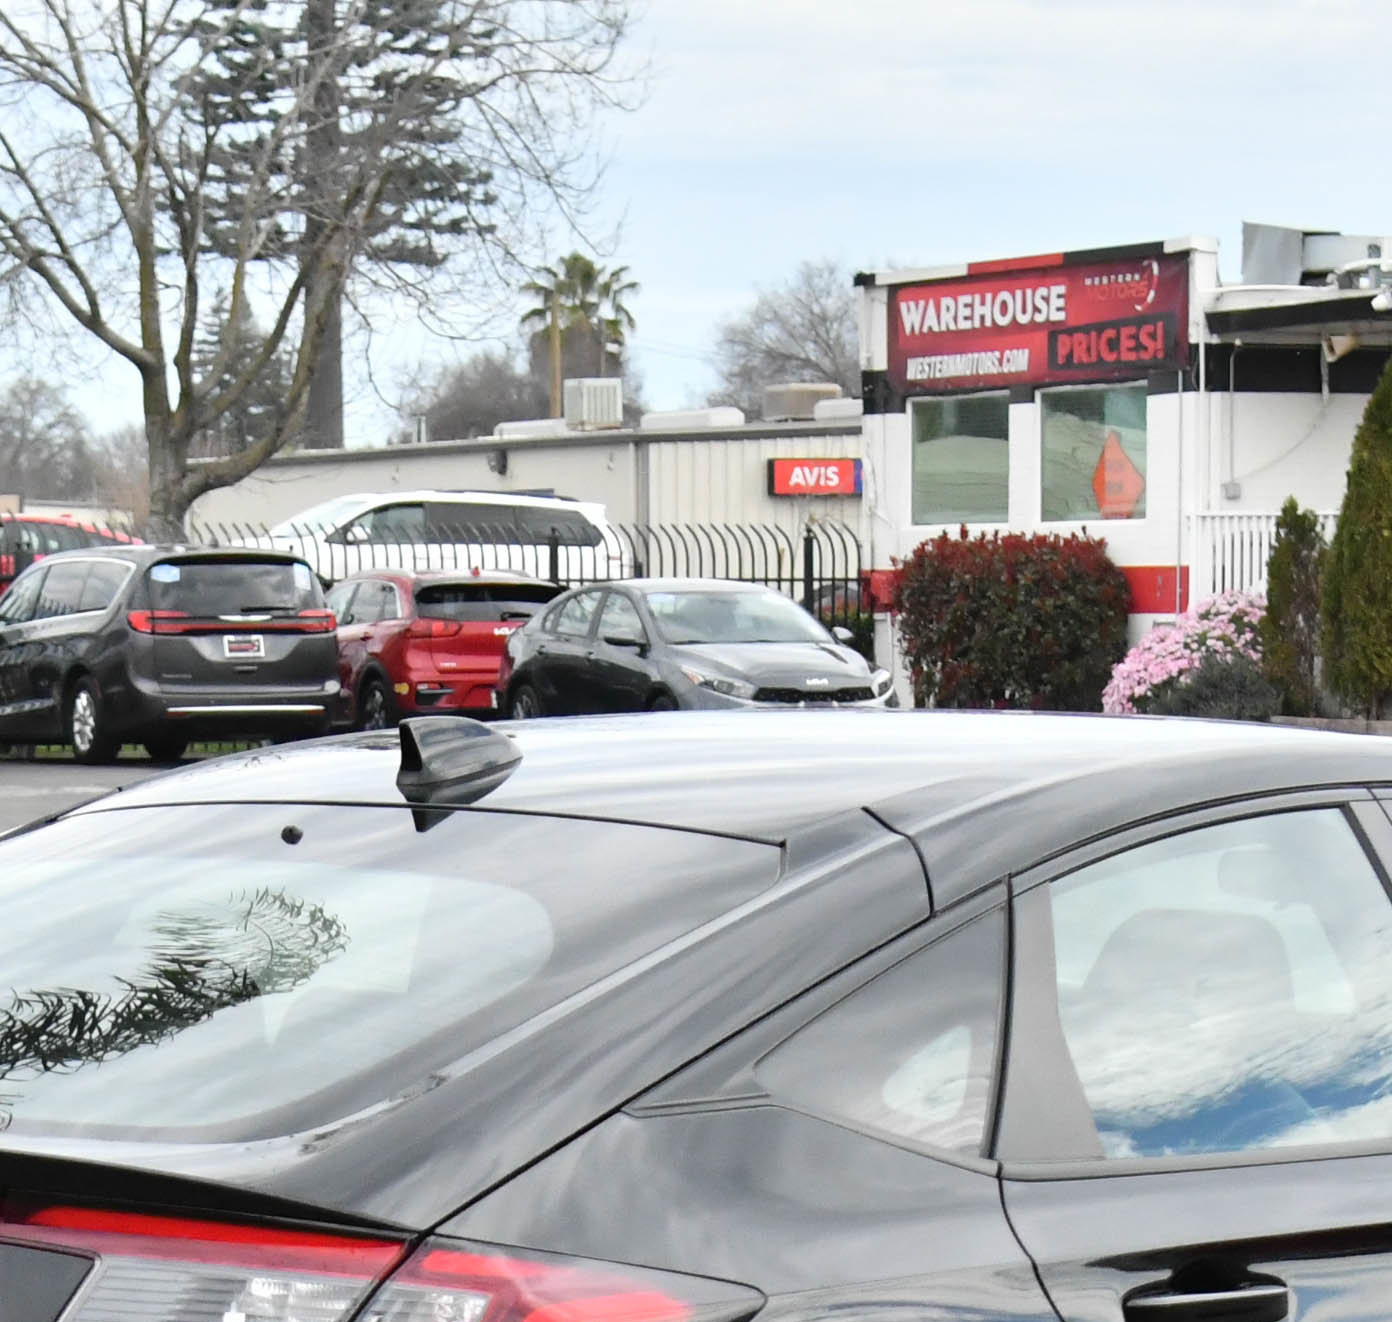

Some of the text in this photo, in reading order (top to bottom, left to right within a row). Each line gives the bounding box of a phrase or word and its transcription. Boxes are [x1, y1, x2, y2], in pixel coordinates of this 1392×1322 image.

[899, 284, 1067, 336] WAREHOUSE
[1056, 320, 1166, 365] PRICES!
[788, 465, 840, 487] AVIS
